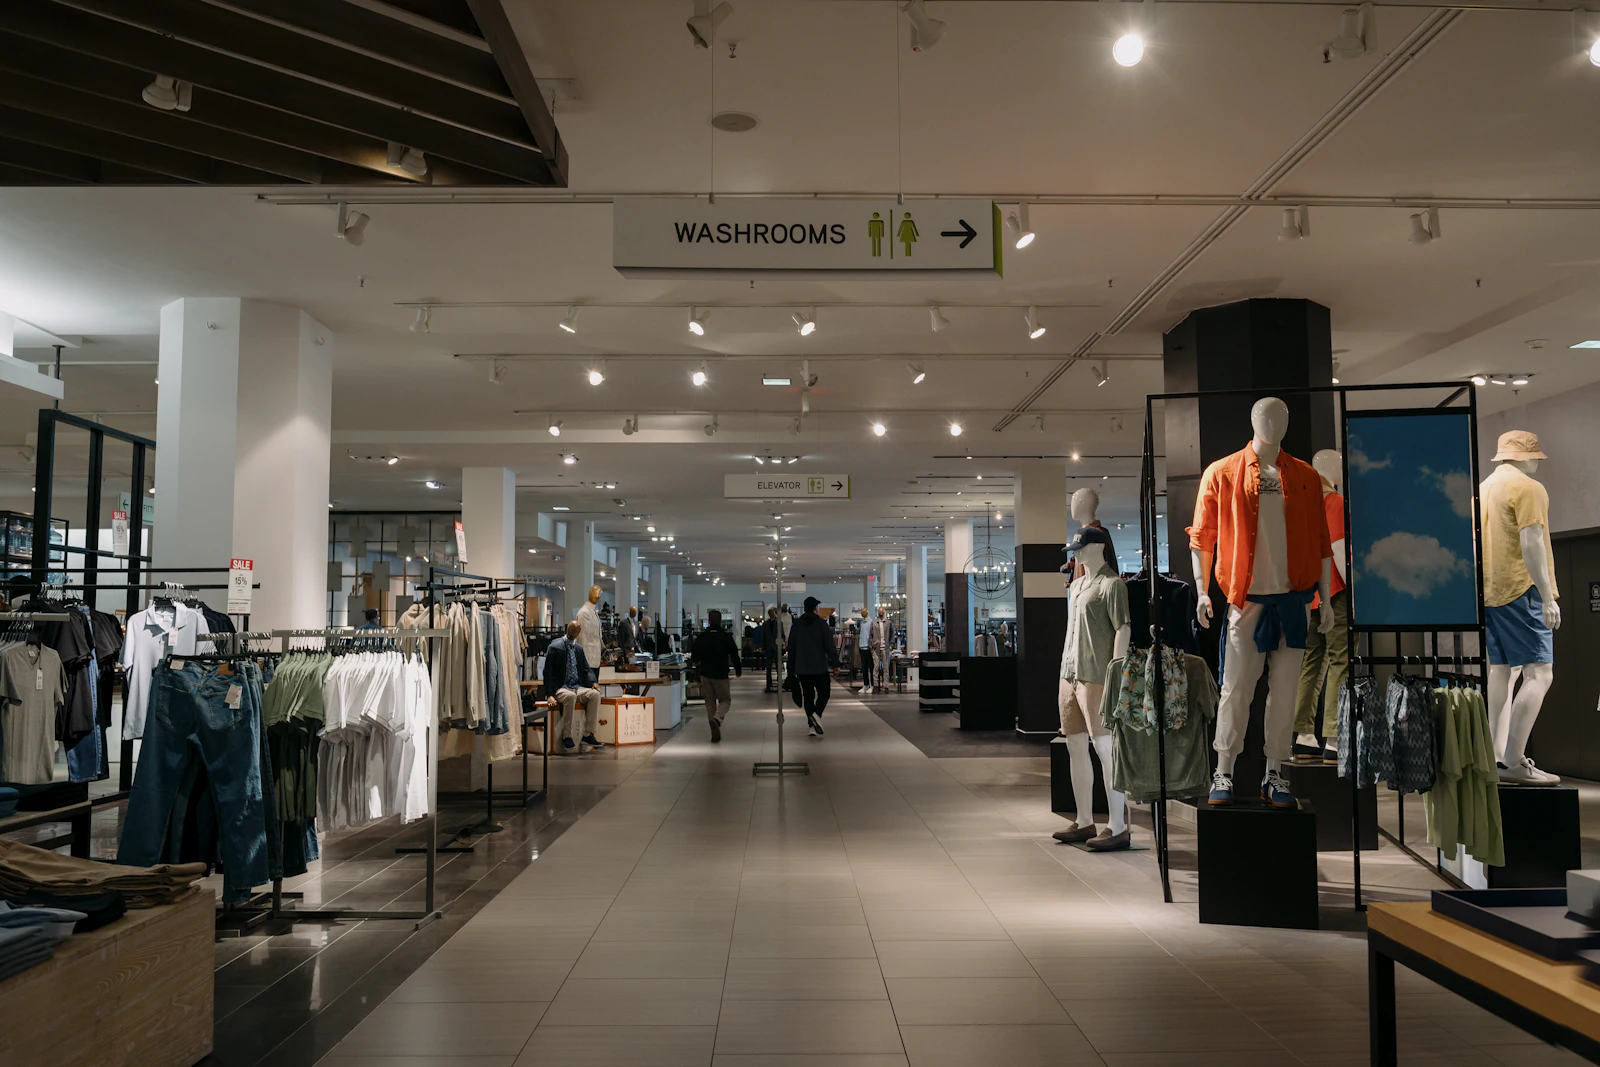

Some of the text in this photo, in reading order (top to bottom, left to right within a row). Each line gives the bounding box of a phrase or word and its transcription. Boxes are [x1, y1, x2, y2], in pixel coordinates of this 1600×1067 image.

[674, 222, 846, 245] WASHROOMS
[757, 481, 801, 490] ELEVATOR
[113, 511, 126, 520] SALE
[232, 559, 251, 570] SALE
[234, 576, 248, 586] 15%
